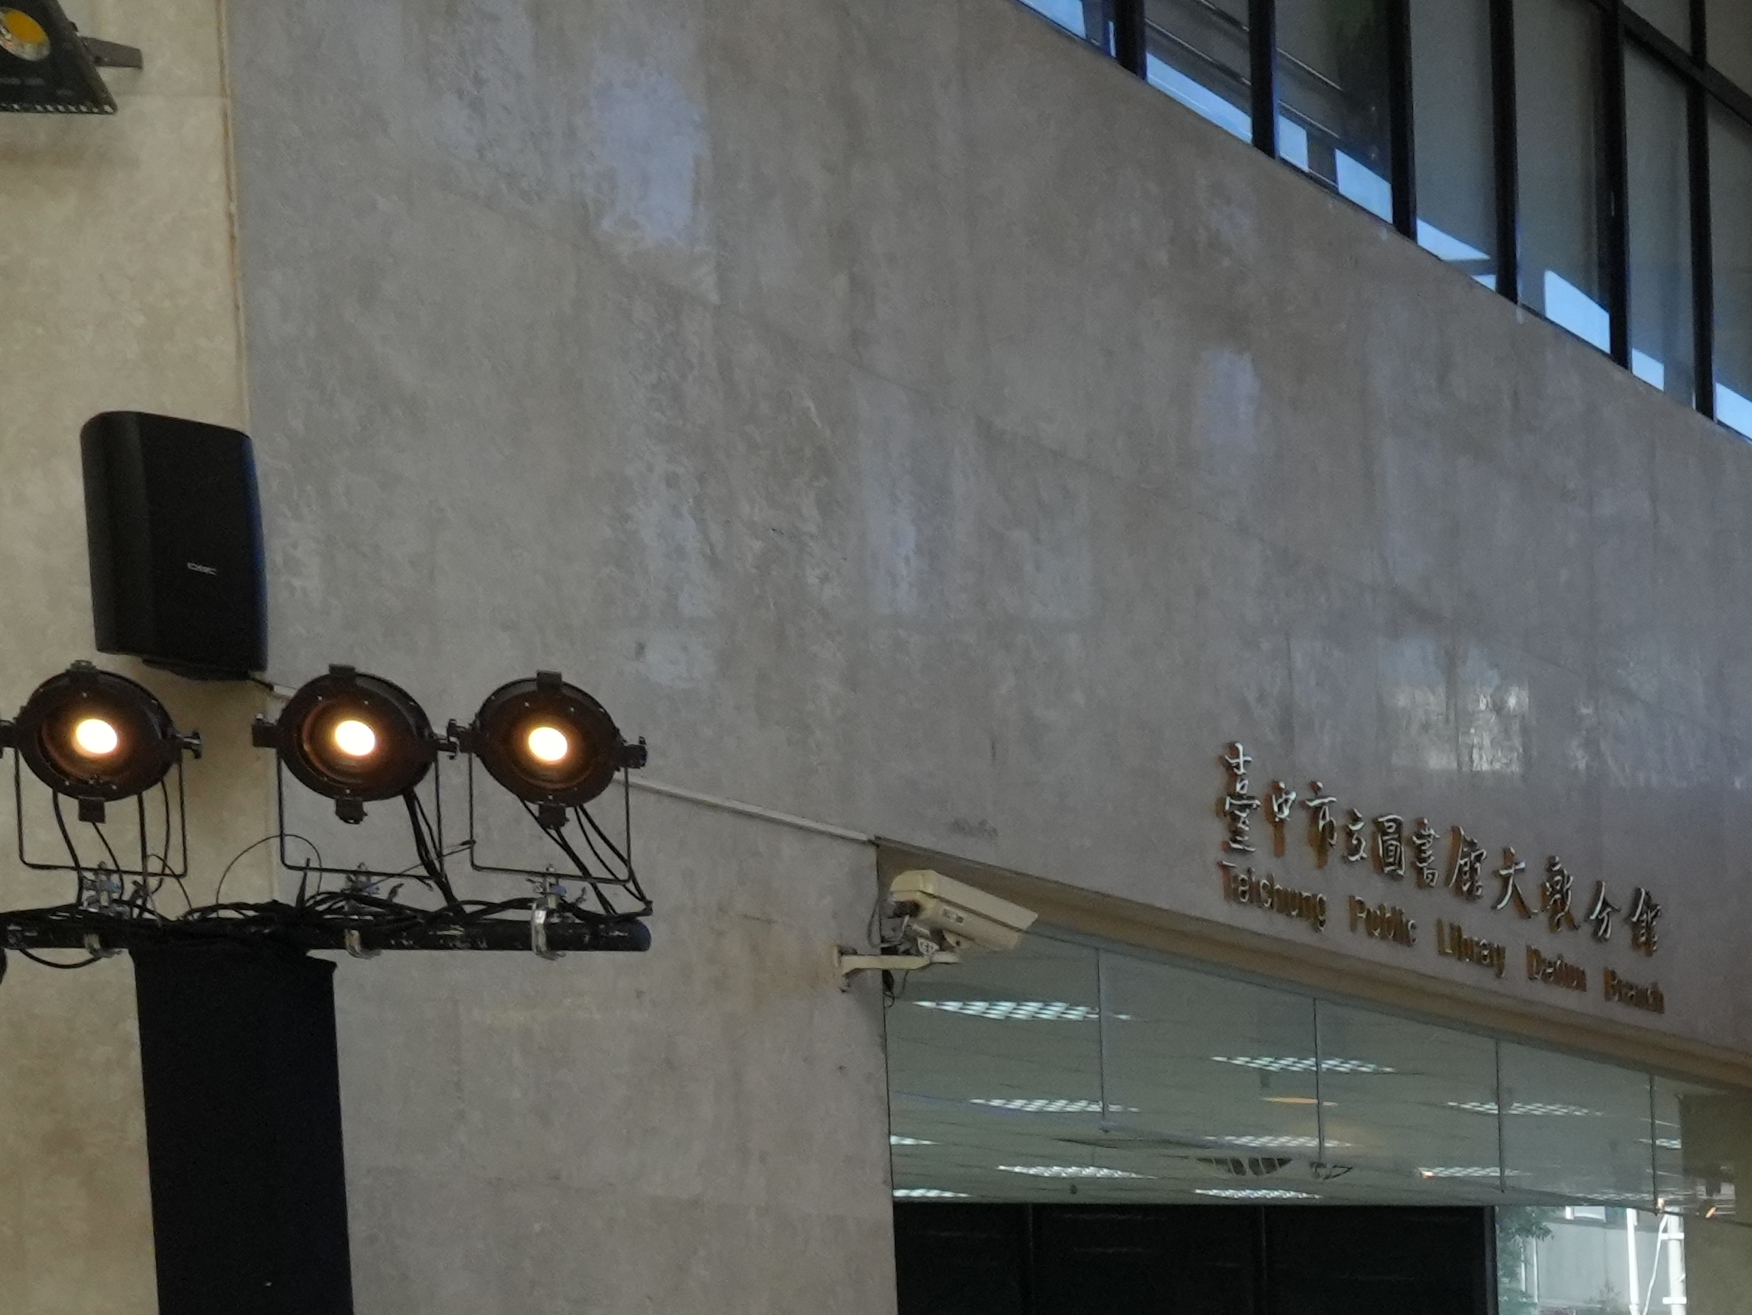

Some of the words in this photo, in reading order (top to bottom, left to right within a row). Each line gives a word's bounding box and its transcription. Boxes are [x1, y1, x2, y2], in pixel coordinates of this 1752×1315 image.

[1219, 860, 1328, 934] Taichung
[1349, 894, 1417, 948] Public
[1436, 918, 1506, 979] Library
